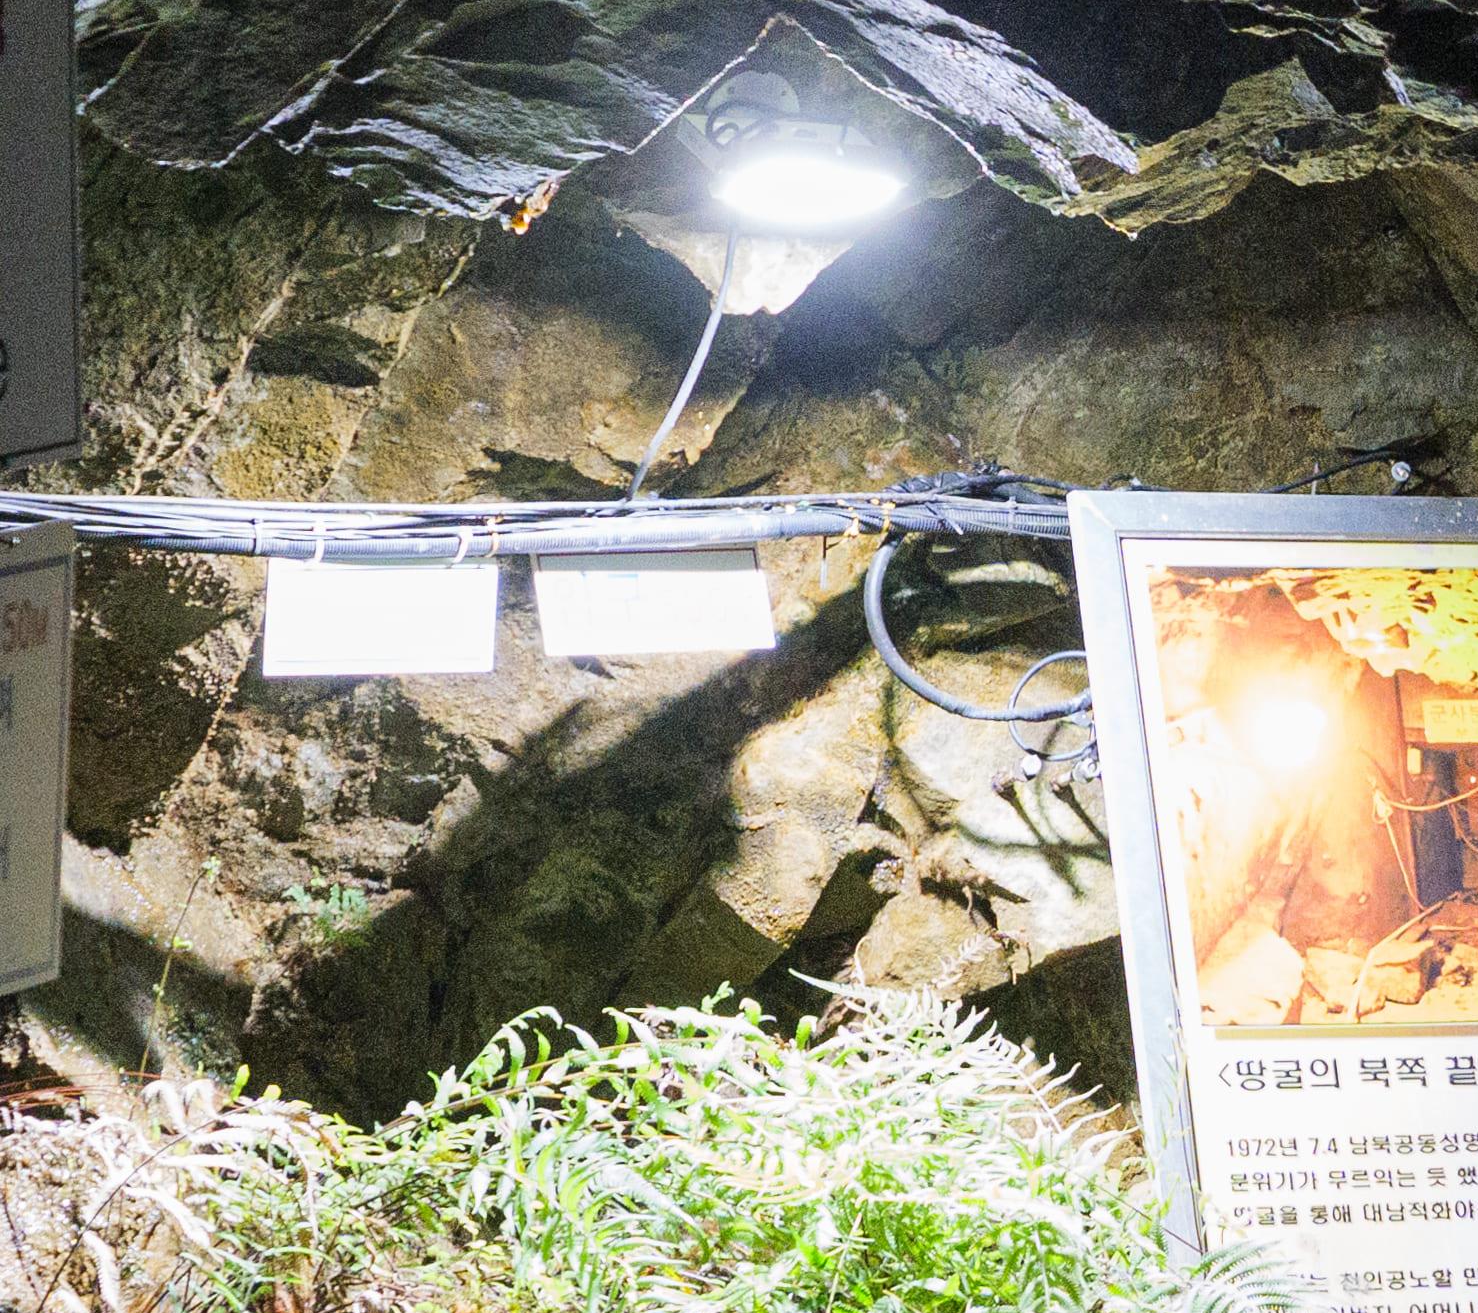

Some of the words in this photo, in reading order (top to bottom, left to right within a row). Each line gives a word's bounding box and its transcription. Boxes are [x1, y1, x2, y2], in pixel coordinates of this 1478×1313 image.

[1358, 1057, 1428, 1088] 북쪽
[1446, 1055, 1478, 1086] 끝
[1226, 1136, 1299, 1158] 1972년
[1309, 1136, 1339, 1155] 7.4
[1230, 1170, 1318, 1193] 분위기가
[1328, 1166, 1417, 1190] 무르익는
[1426, 1166, 1447, 1189] 듯
[1309, 1202, 1353, 1224] 통해
